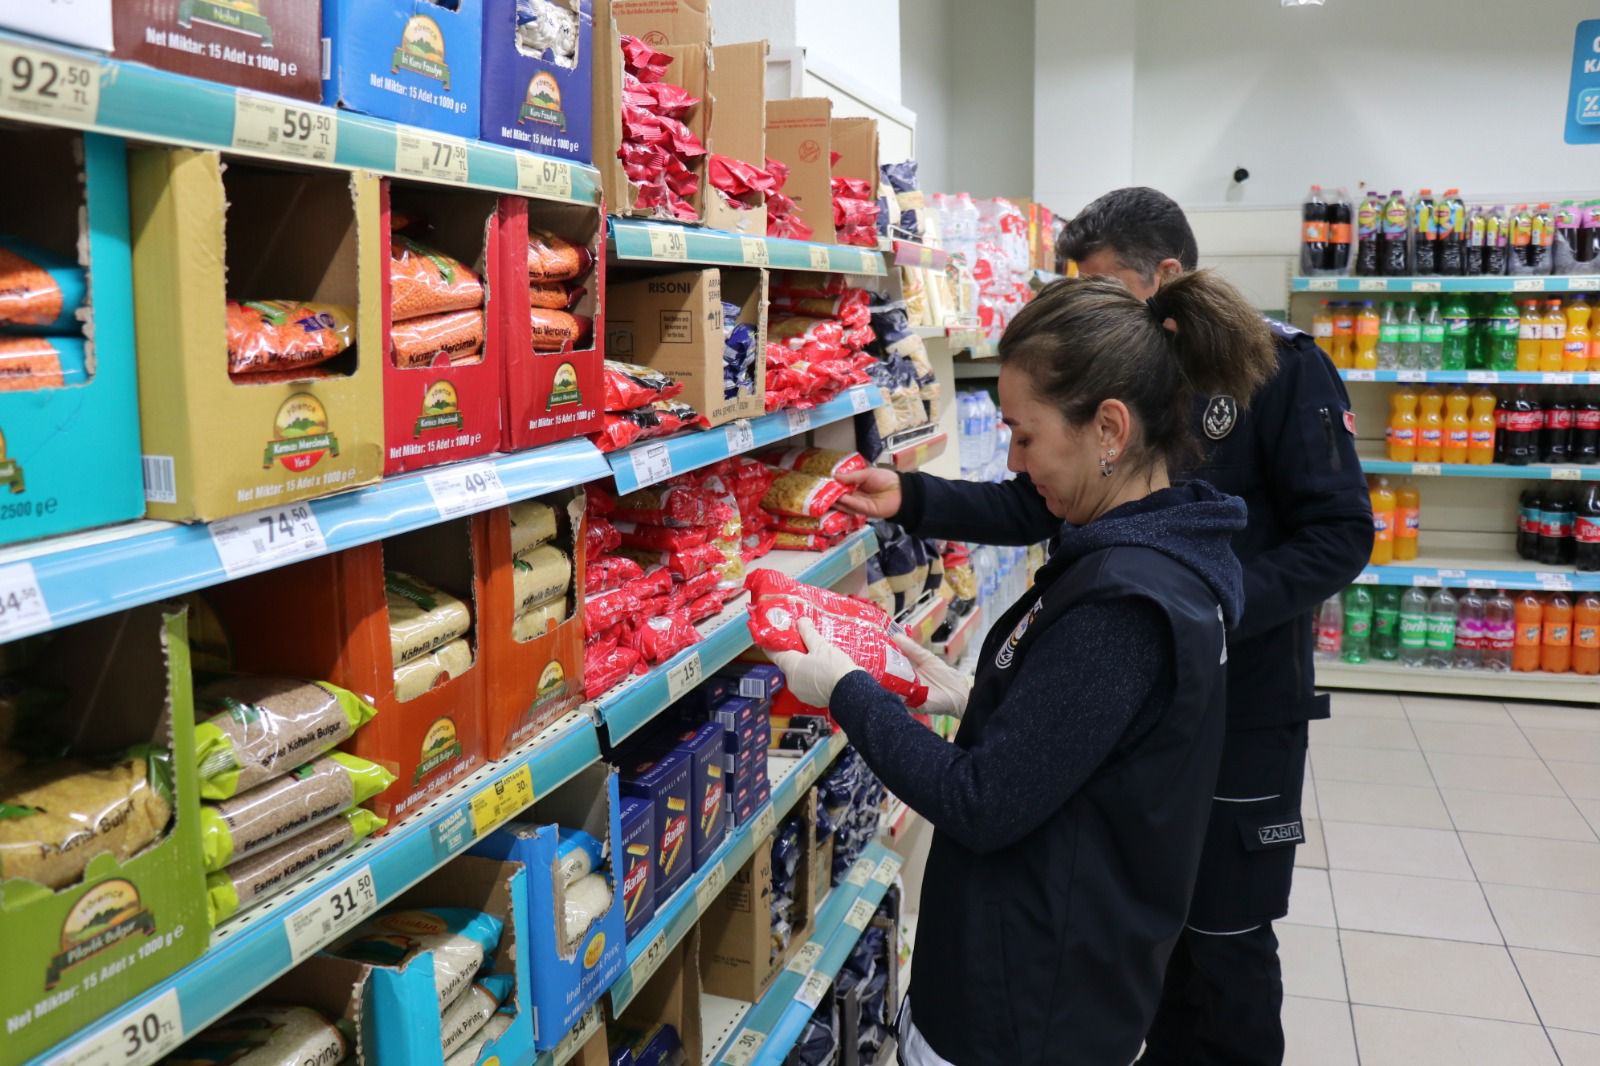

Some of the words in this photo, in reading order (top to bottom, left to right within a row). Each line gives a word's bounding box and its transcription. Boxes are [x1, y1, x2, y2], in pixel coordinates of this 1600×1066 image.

[145, 27, 166, 46] Net
[168, 33, 206, 55] Miktar:
[209, 43, 221, 59] 15
[223, 46, 246, 65] Adet
[248, 57, 254, 66] x
[257, 54, 279, 72] 1000
[73, 89, 88, 105] TL
[370, 73, 382, 88] Net
[383, 77, 407, 97] Miktar:
[409, 86, 417, 99] 15
[418, 88, 433, 105] Adet
[439, 96, 454, 111] 1000
[320, 132, 330, 145] TL
[501, 126, 512, 138] Net
[513, 129, 531, 144] Miktar:
[532, 133, 540, 145] 15
[540, 134, 552, 147] Adet
[557, 138, 569, 151] 1000
[459, 160, 466, 171] TL
[648, 282, 691, 294] RISONI
[441, 337, 477, 354] Mercimek
[298, 438, 330, 450] Mercimek
[390, 446, 401, 459] Net
[403, 441, 425, 457] Miktar:
[427, 439, 435, 452] 15
[436, 437, 450, 450] Adet
[456, 433, 470, 448] 1000
[294, 454, 310, 467] Yerli
[237, 487, 255, 503] Net
[257, 481, 284, 501] Miktar:
[286, 480, 296, 494] 15
[297, 474, 315, 492] Adet
[323, 470, 342, 484] 1000
[1, 502, 31, 519] 2500
[303, 522, 314, 533] TL
[390, 581, 425, 602] ulgur
[401, 641, 431, 662] Köftelik
[287, 731, 315, 753] Köftelik
[317, 719, 341, 739] Bulgur
[395, 803, 407, 815] Net
[427, 784, 435, 796] 15
[435, 776, 448, 792] Adet
[453, 764, 466, 780] 1000
[244, 832, 274, 853] Esmer
[664, 820, 687, 847] Barilla
[1261, 825, 1300, 842] ZABITA
[254, 872, 283, 893] Esmer
[283, 852, 317, 877] Köftelik
[317, 837, 345, 858] Bulgur
[623, 865, 648, 896] Barilla
[363, 889, 374, 900] TL
[6, 1009, 32, 1034] Net
[35, 982, 80, 1016] Miktar:
[83, 974, 97, 991] 15
[99, 960, 127, 982] Adet
[138, 938, 165, 960] 1000
[122, 1012, 160, 1057] 30
[161, 1019, 175, 1035] TL
[739, 1034, 756, 1048] 30
